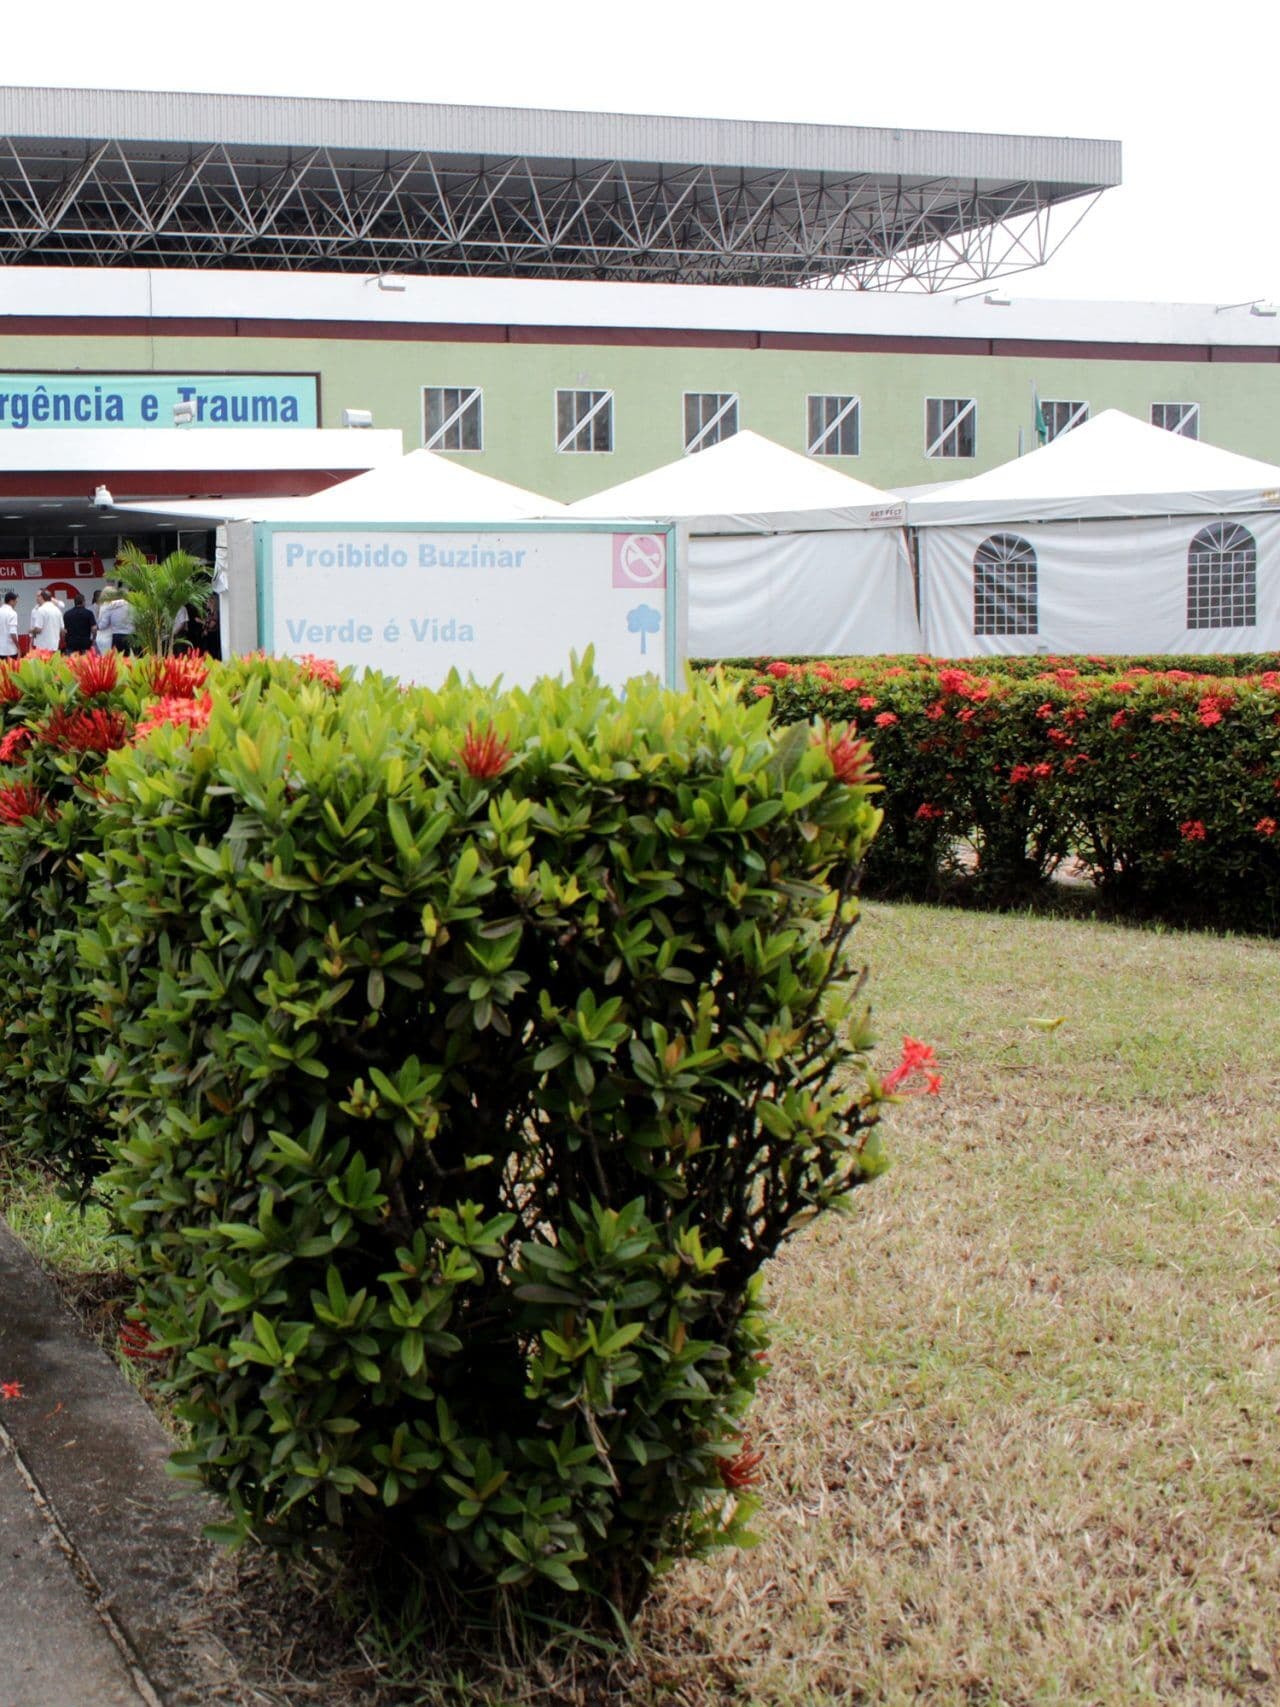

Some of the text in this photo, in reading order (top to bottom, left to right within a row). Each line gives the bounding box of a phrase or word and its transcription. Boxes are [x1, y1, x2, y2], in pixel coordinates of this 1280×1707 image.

[140, 394, 158, 422] e
[177, 387, 298, 422] Trauma
[286, 543, 527, 568] Proibido Buzinar
[286, 617, 475, 643] Verde é Vida
